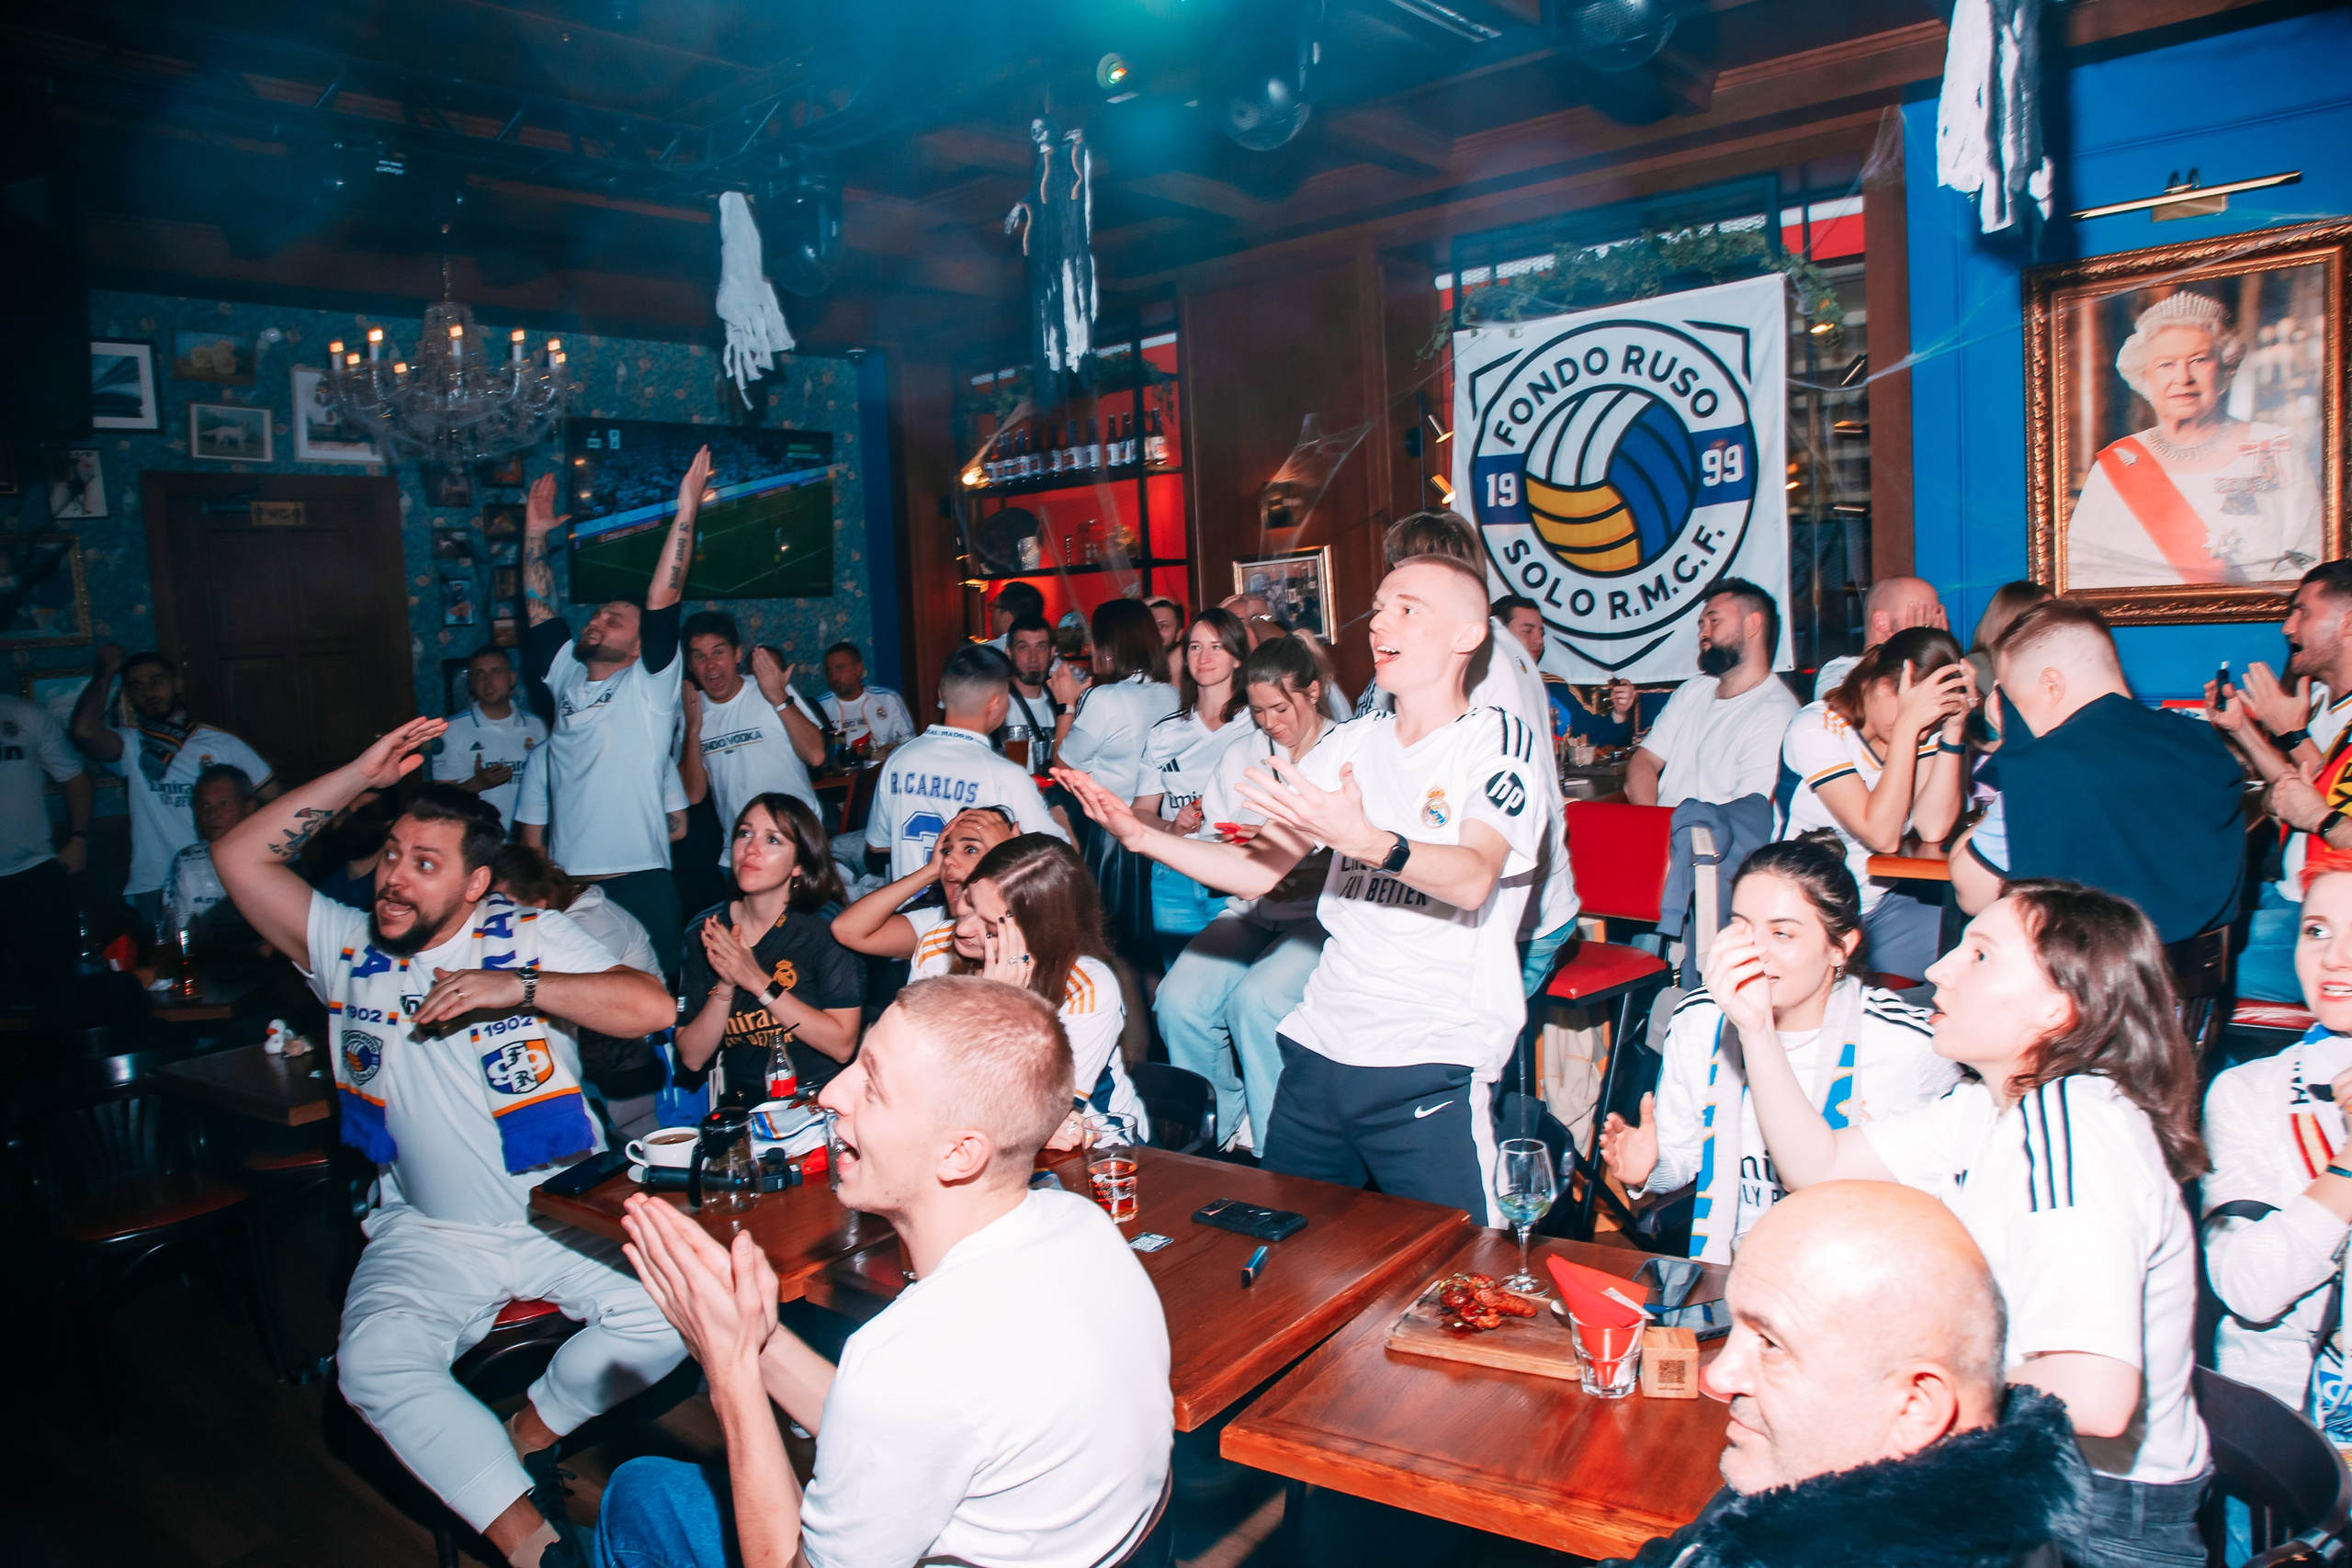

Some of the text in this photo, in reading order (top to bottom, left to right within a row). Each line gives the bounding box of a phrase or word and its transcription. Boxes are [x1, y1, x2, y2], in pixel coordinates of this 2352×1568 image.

[1493, 344, 1719, 447] FONDO RUSO
[1486, 444, 1743, 508] 19 99
[1503, 525, 1726, 621] SOLO R.M.C.F.
[725, 730, 763, 746] VODKA
[889, 771, 980, 805] R.CARLOS
[1487, 769, 1524, 814] hp
[346, 1004, 382, 1023] 1902
[483, 1015, 533, 1038] 1902
